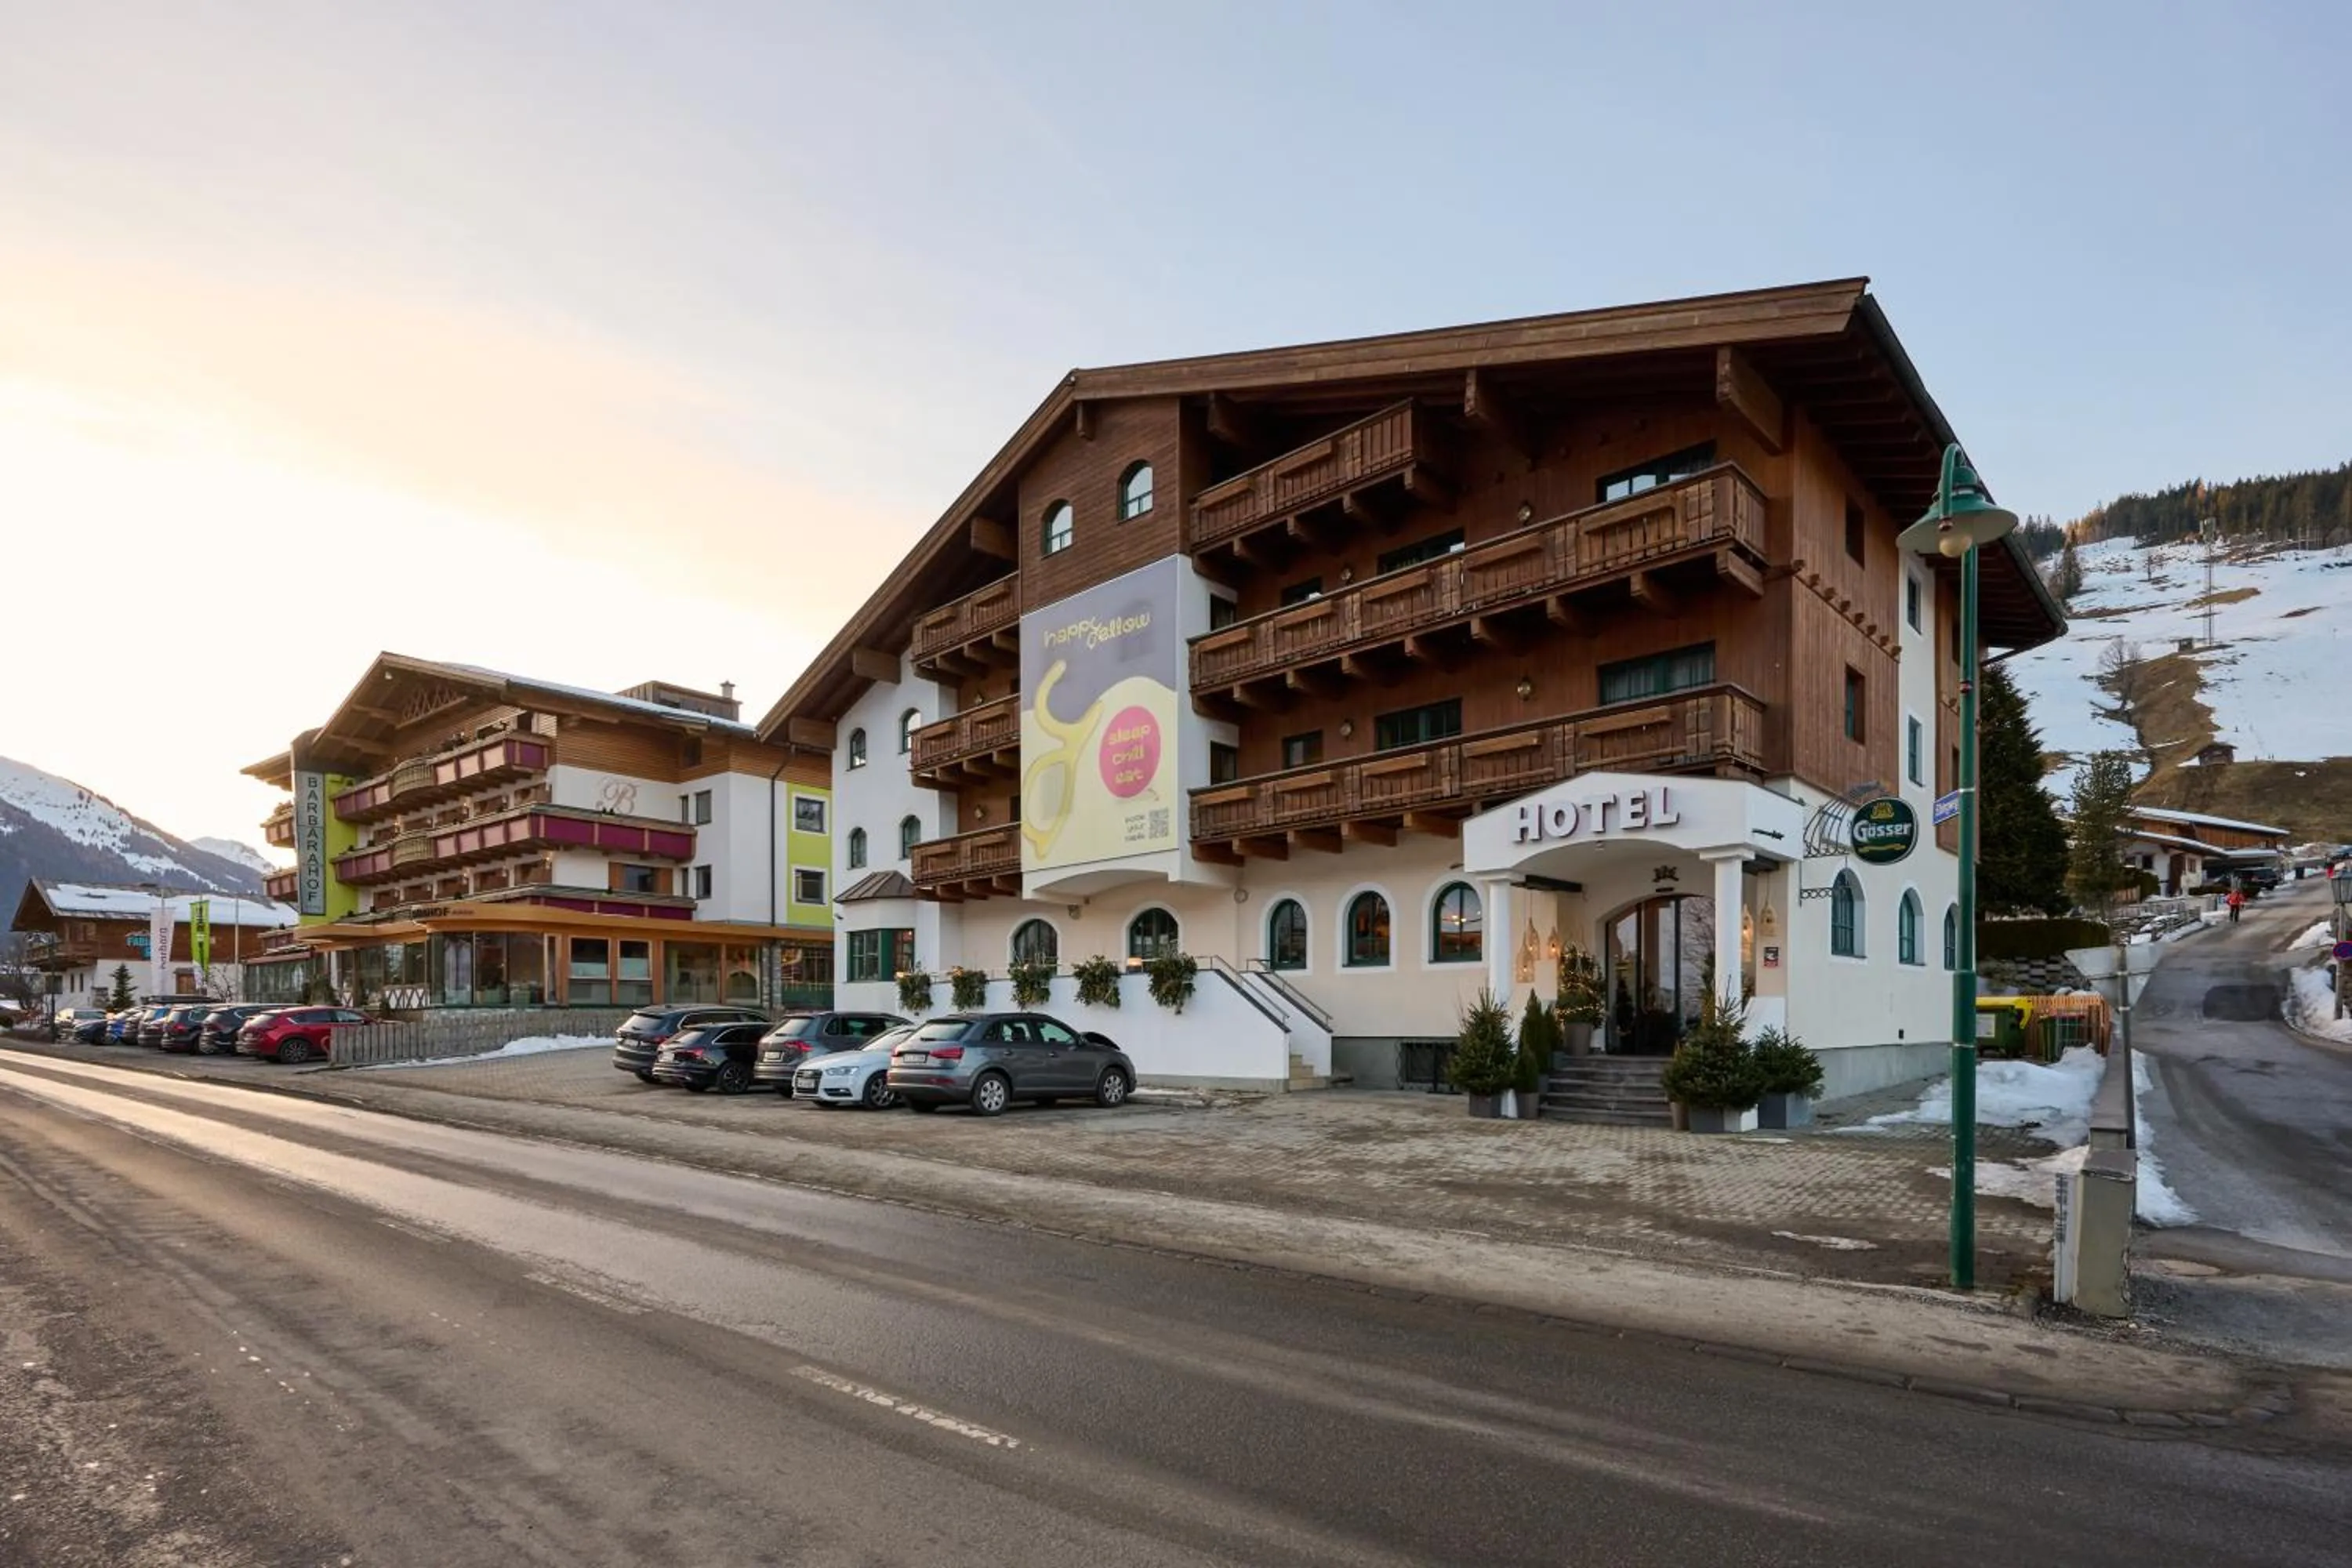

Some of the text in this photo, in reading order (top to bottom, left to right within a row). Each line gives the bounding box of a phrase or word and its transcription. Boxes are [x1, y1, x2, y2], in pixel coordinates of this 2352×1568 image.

[307, 777, 319, 902] BARBARAHOF
[1512, 786, 1680, 843] HOTEL
[1853, 820, 1911, 843] Gösser
